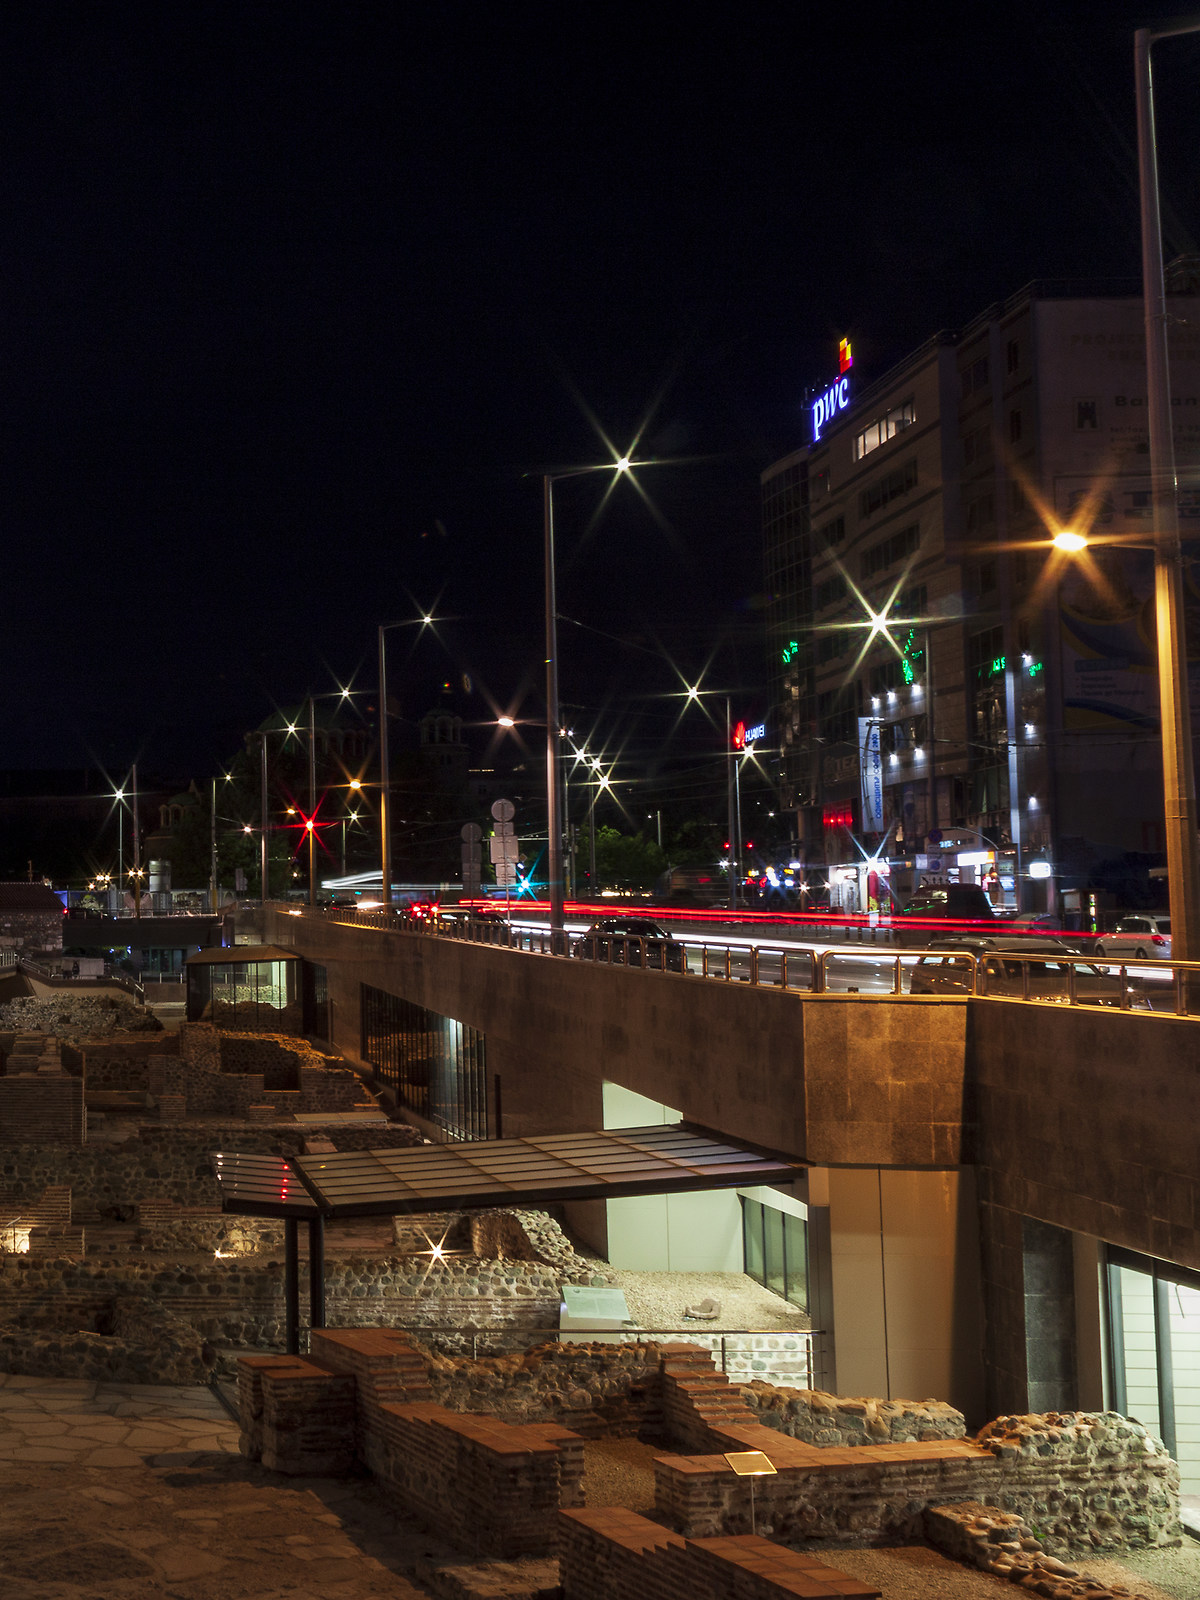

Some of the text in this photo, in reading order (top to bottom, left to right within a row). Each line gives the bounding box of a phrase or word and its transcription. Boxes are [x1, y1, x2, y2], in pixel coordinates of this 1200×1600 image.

[812, 378, 849, 442] pwc
[745, 724, 765, 743] HUAWEI
[871, 733, 879, 748] 2000
